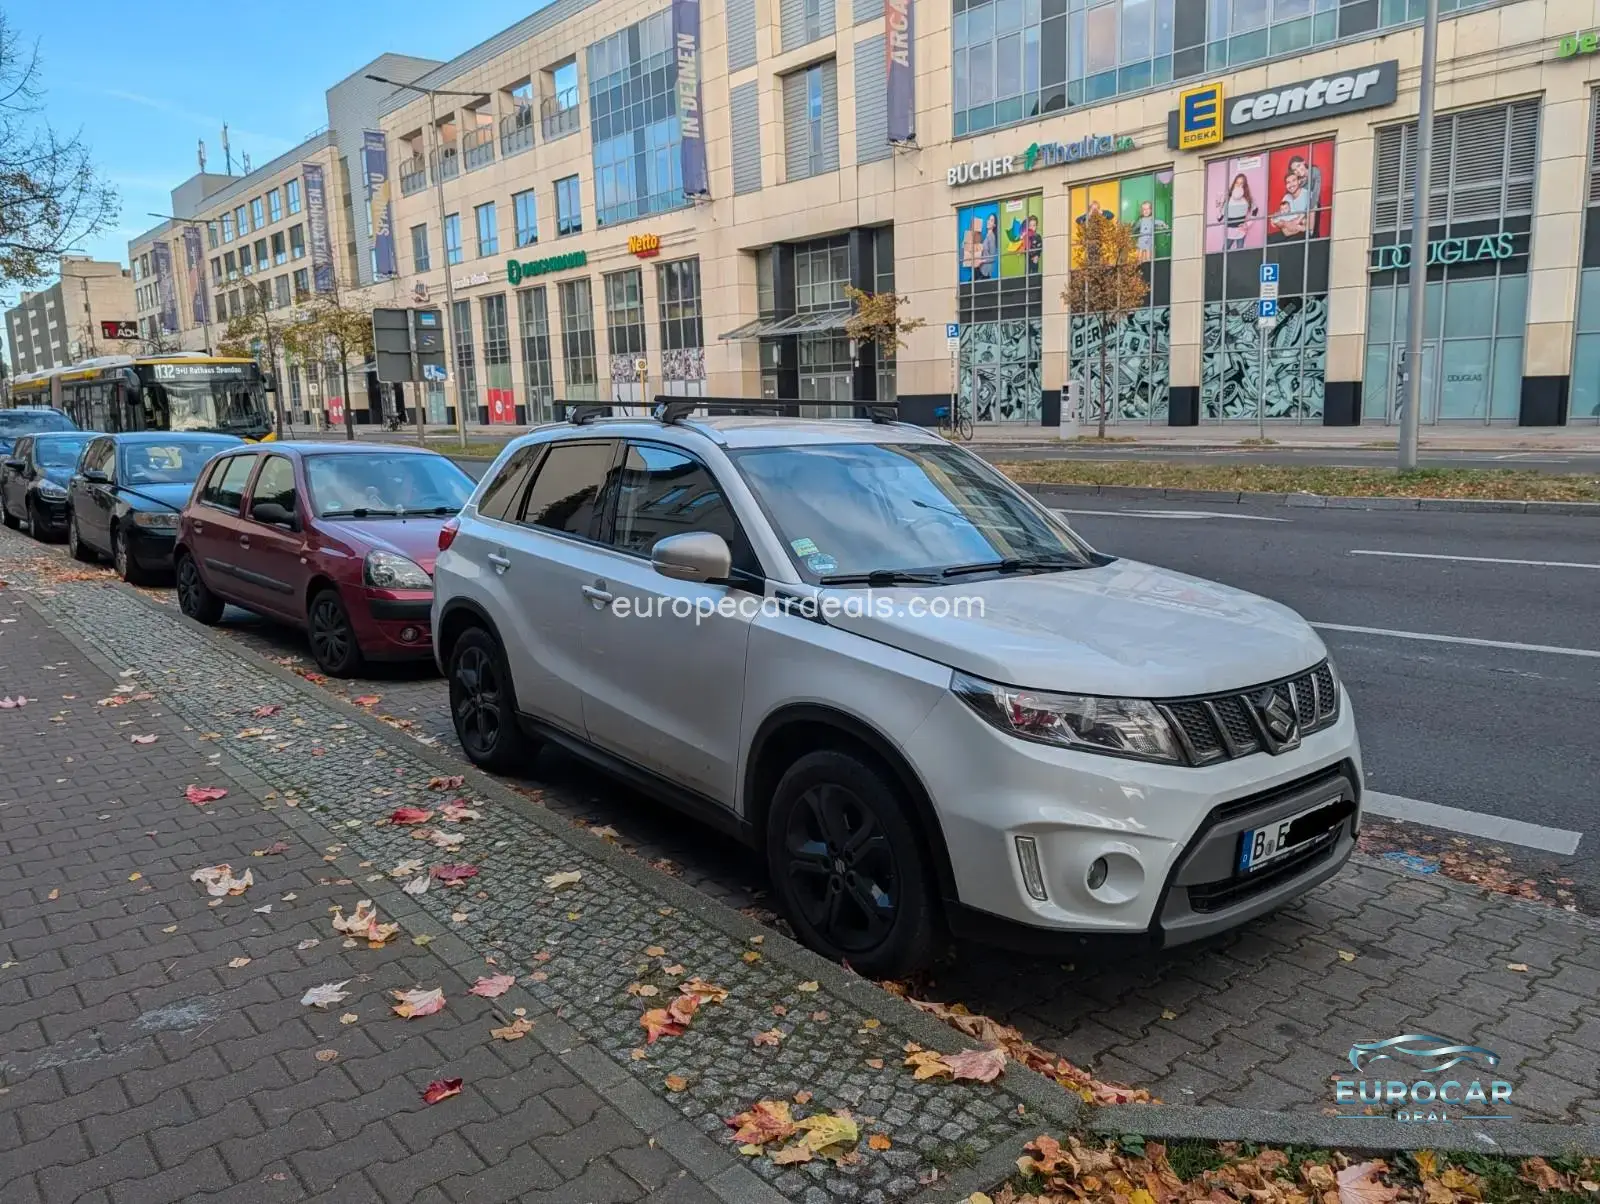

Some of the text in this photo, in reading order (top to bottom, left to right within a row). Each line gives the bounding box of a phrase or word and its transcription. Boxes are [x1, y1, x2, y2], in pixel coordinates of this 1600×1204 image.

[677, 33, 700, 138] IN DEINEN
[1230, 69, 1381, 125] center
[1184, 89, 1217, 132] E
[1183, 130, 1217, 143] EDEKA
[946, 155, 1014, 186] BÜCHER
[627, 233, 659, 254] Netto
[1263, 266, 1274, 281] P
[1262, 301, 1273, 316] P
[1074, 322, 1118, 349] BERIN
[1252, 830, 1266, 860] B
